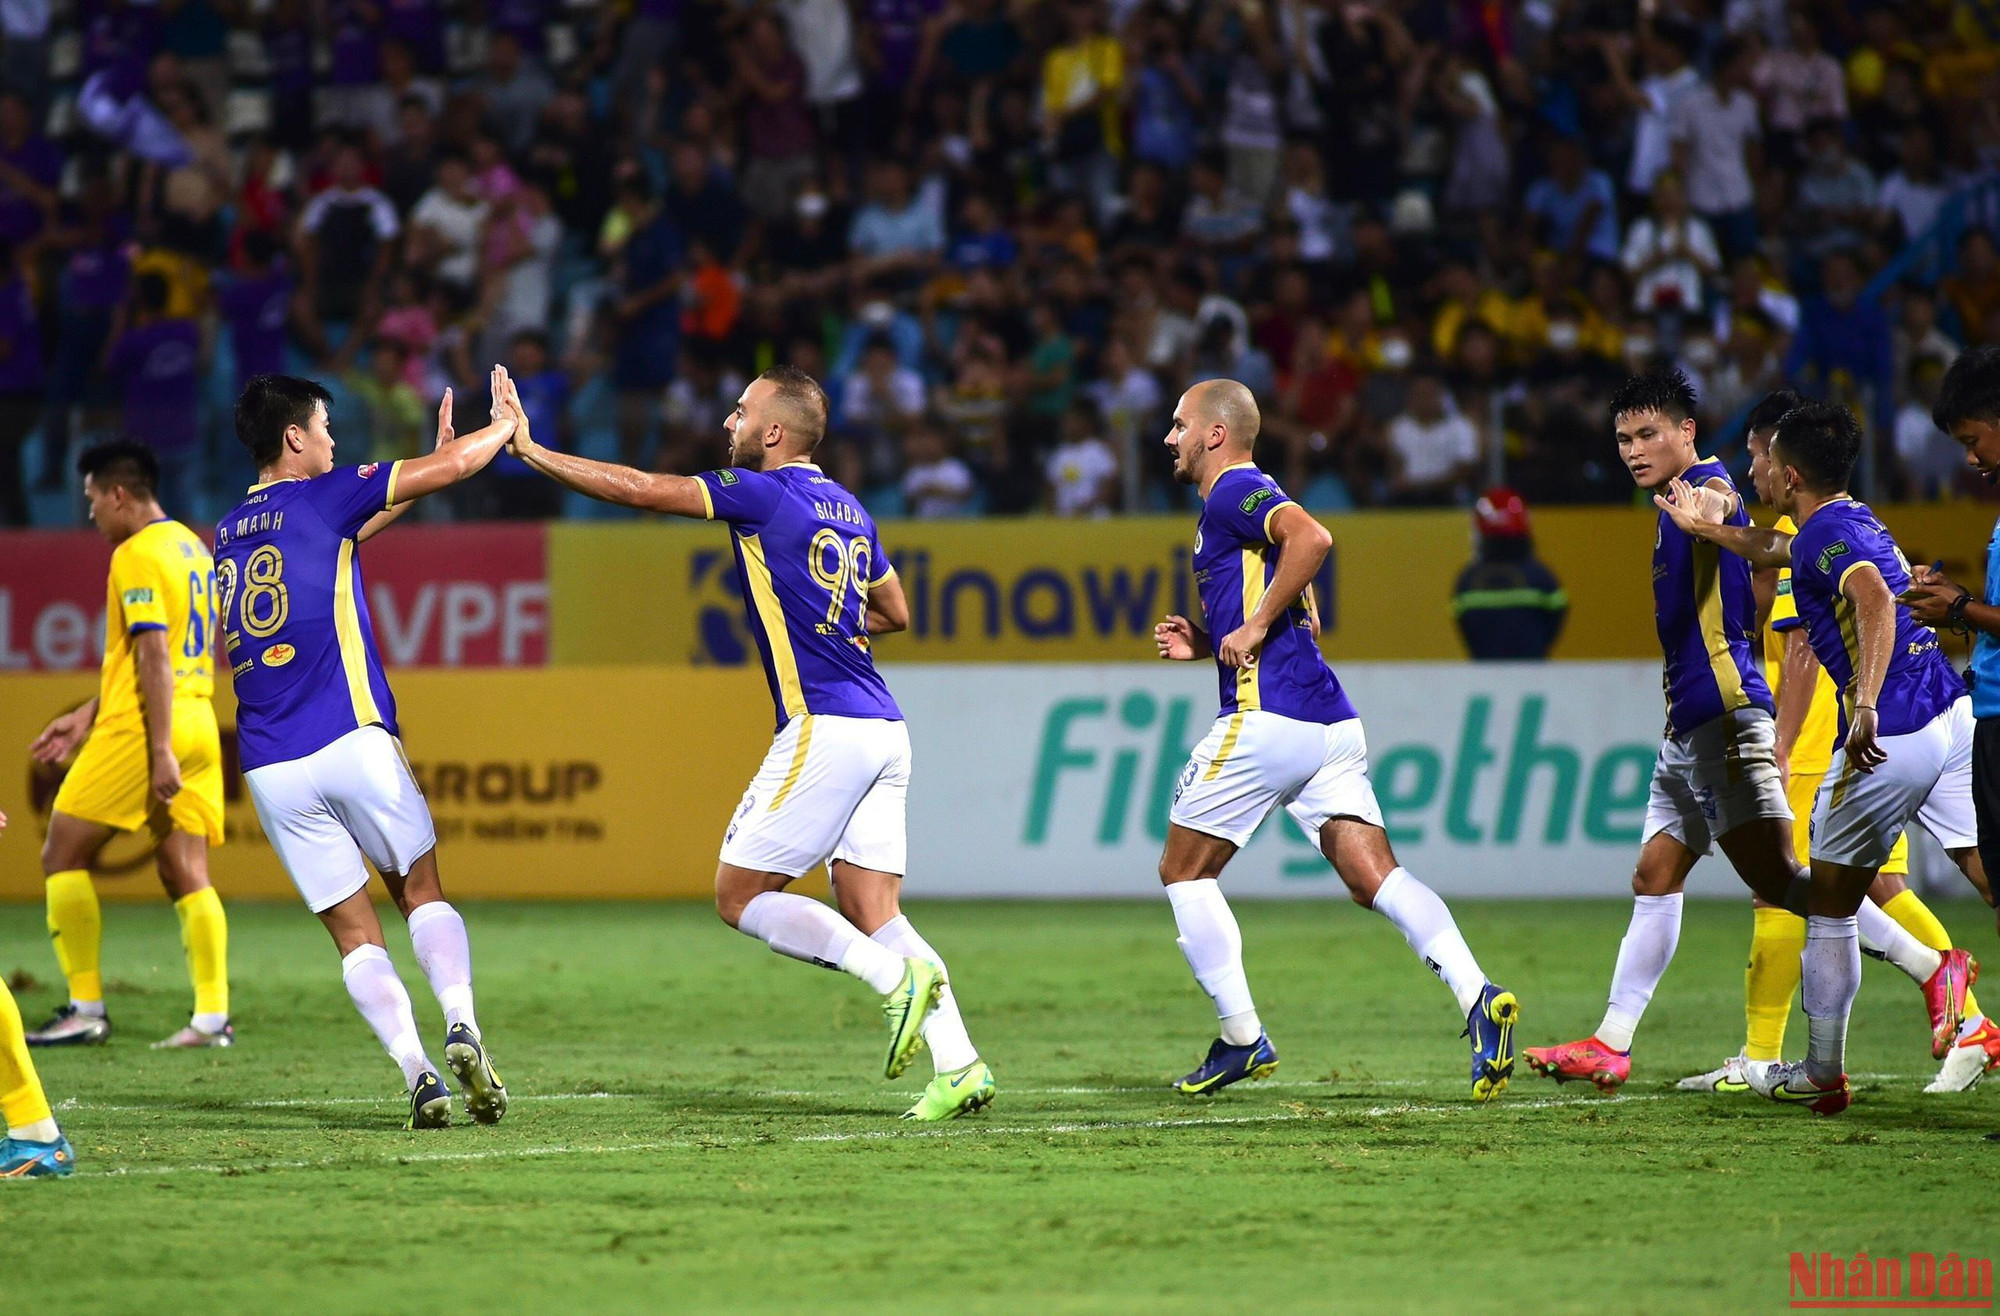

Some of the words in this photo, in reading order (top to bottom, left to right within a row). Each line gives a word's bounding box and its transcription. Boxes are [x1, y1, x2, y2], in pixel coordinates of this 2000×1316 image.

[814, 501, 864, 527] SILADJI
[217, 544, 289, 653] 28
[372, 580, 548, 664] VPF
[808, 527, 872, 631] 99
